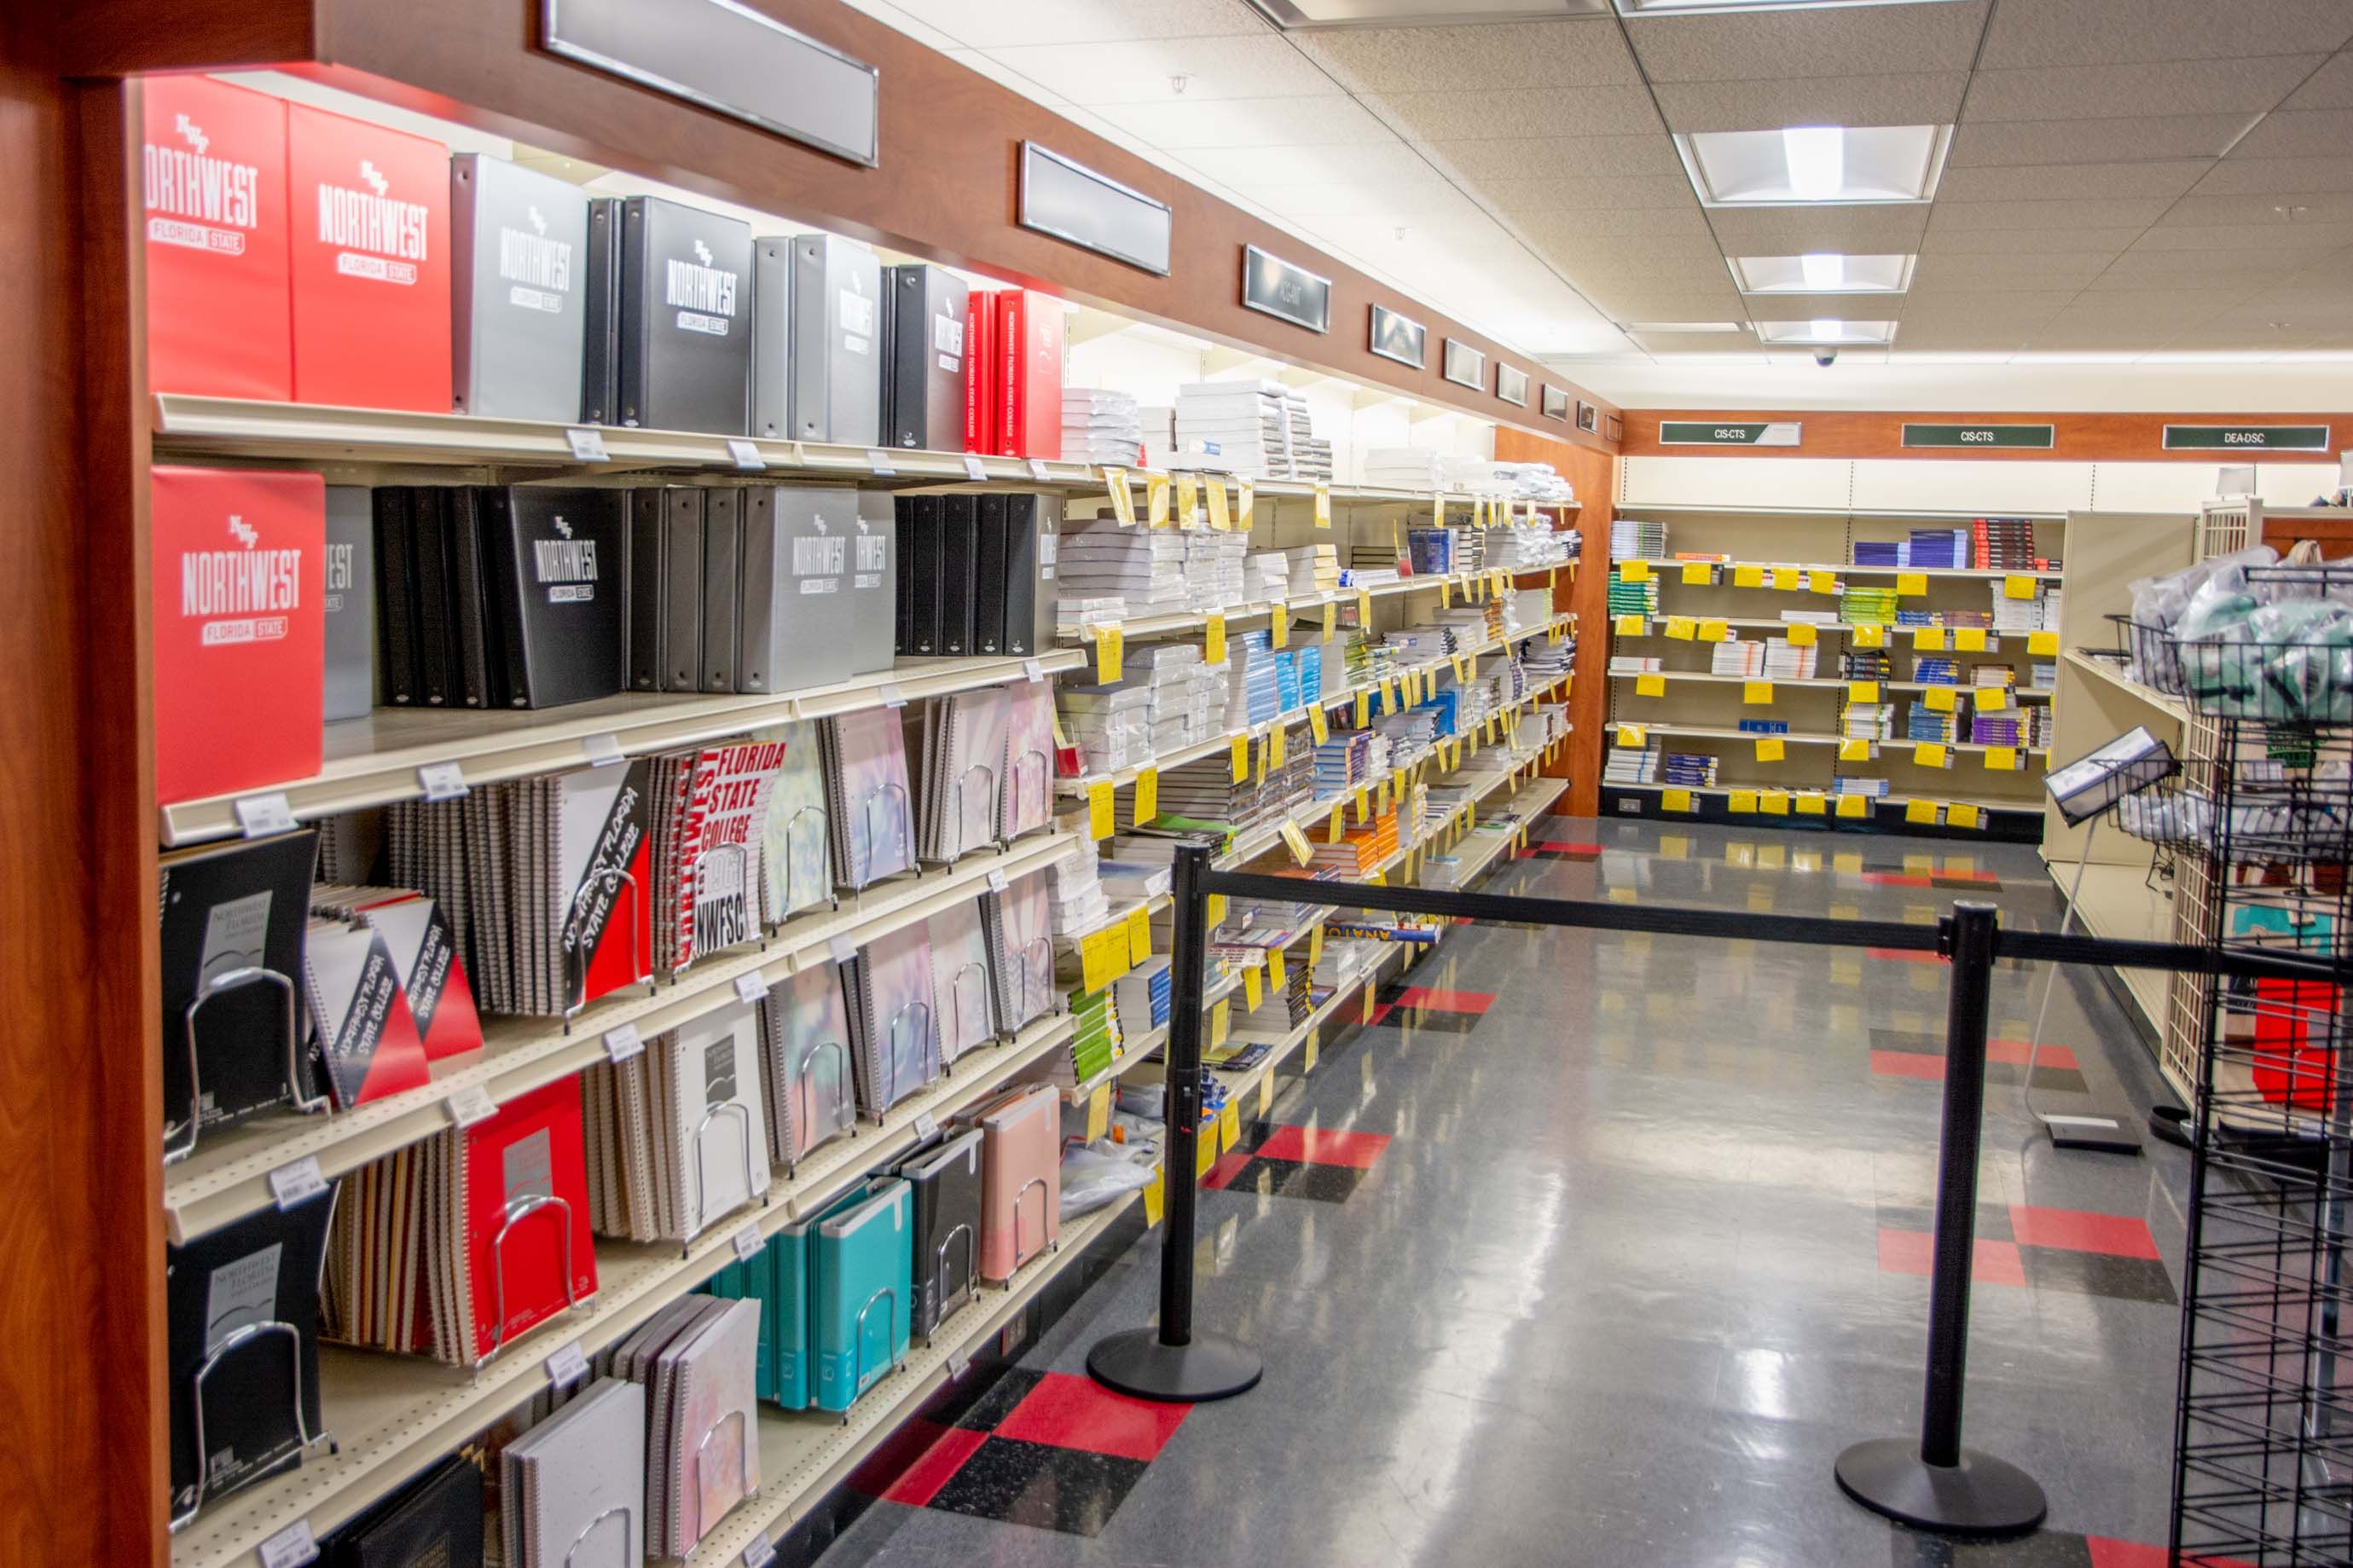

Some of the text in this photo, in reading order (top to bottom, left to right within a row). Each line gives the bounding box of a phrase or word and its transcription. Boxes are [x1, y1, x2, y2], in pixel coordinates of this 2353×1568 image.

[145, 143, 258, 229] ORTHWEST
[154, 223, 241, 251] FLORIDA STATE
[319, 183, 428, 262] NORTHWEST
[388, 263, 414, 282] STATE
[667, 258, 737, 316] NORTHWEST
[1714, 429, 1746, 439] CIS-CTS
[1961, 431, 1994, 442] CIS-CTS
[2224, 432, 2265, 443] DEA-DSC
[535, 540, 598, 582] NORTHWEST
[793, 536, 845, 576] NORTHWEST
[856, 535, 886, 570] THWEST
[183, 550, 301, 617] NORTHWEST
[206, 619, 285, 640] FLORIDA STATE
[716, 743, 786, 777] FLORIDA
[709, 777, 761, 814] STATE
[701, 813, 751, 852] COLLEGE
[582, 893, 609, 949] STATE
[696, 892, 744, 954] NWFSC
[357, 975, 394, 1055] STATE COLLEGE
[418, 987, 437, 1018] STATE
